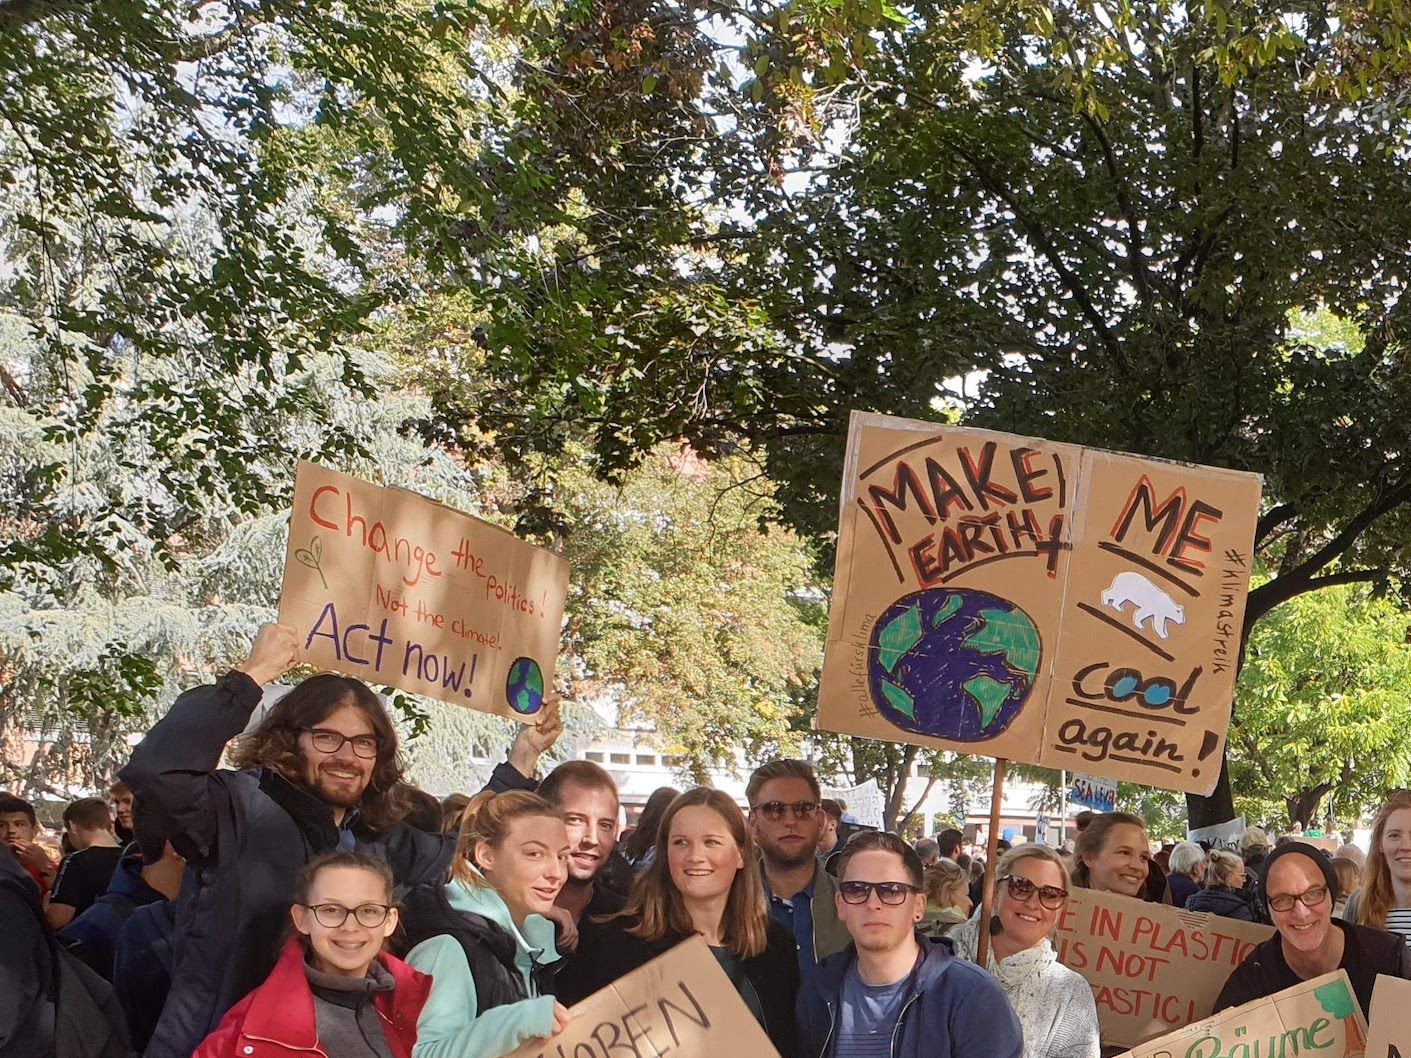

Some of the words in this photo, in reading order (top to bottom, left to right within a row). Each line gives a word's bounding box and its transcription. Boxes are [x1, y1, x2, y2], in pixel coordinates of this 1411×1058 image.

[309, 485, 443, 587] Change
[451, 537, 486, 578] the
[868, 441, 1054, 545] MAKE
[1110, 474, 1223, 577] ME
[908, 510, 1043, 591] EARTH
[304, 602, 393, 673] Act
[402, 639, 479, 699] now!
[376, 584, 409, 617] Not
[412, 601, 445, 629] the
[1089, 903, 1123, 942] IN
[1096, 946, 1171, 982] NOT
